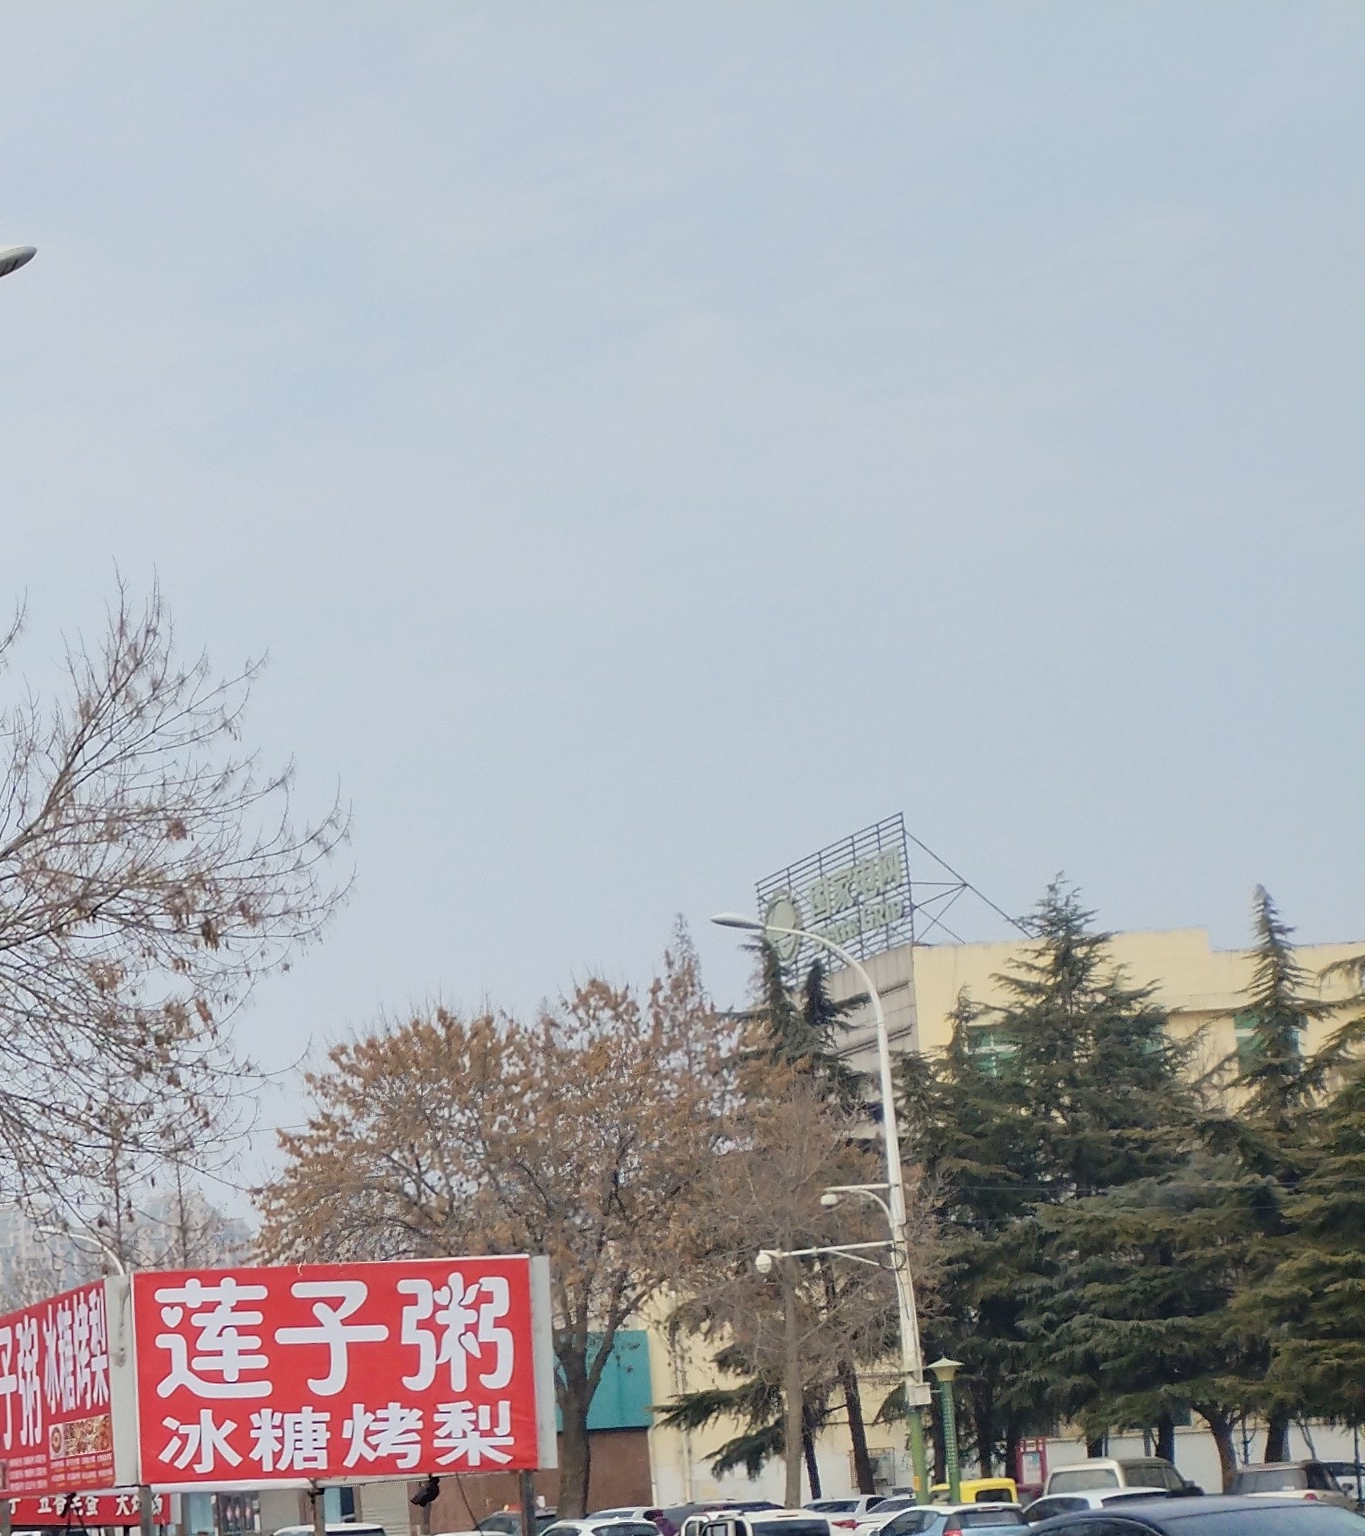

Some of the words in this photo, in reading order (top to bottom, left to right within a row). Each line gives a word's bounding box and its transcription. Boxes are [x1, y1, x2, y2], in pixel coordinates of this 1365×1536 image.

[153, 1271, 516, 1400] 莲子粥
[156, 1398, 516, 1475] 冰糖烤梨
